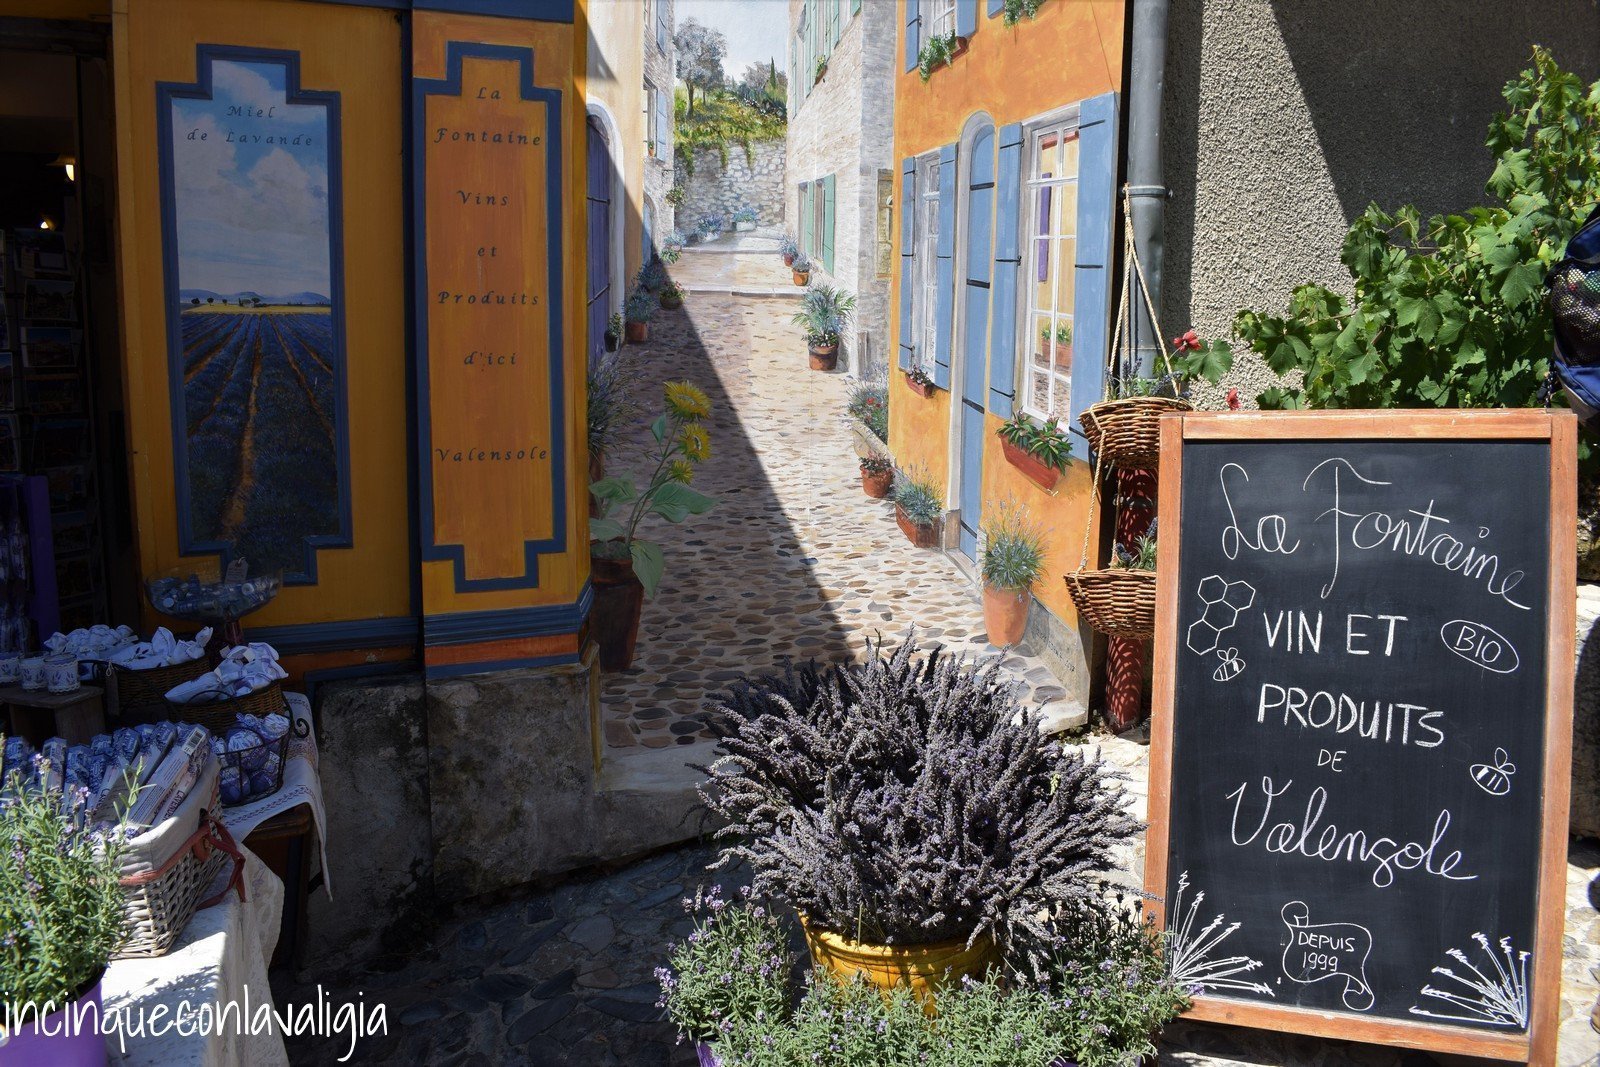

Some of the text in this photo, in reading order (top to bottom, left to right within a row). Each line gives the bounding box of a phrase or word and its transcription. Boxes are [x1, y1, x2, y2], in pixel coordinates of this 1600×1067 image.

[477, 86, 501, 99] La
[226, 105, 276, 118] Miel
[187, 128, 312, 146] de Lavande
[434, 128, 541, 146] Fontaine
[456, 190, 509, 206] Vins
[477, 246, 497, 257] et
[438, 290, 538, 305] Produits
[464, 351, 517, 365] d'ici
[435, 446, 547, 462] Valensole
[1220, 457, 1532, 610] La Fontaine
[1263, 610, 1409, 656] VIN ET
[1453, 625, 1501, 663] BIO
[1257, 683, 1444, 748] PRODUITS
[1317, 749, 1347, 772] DE
[1225, 776, 1478, 888] Valensole
[1298, 931, 1356, 953] DEPUIS
[1303, 952, 1338, 972] 1999
